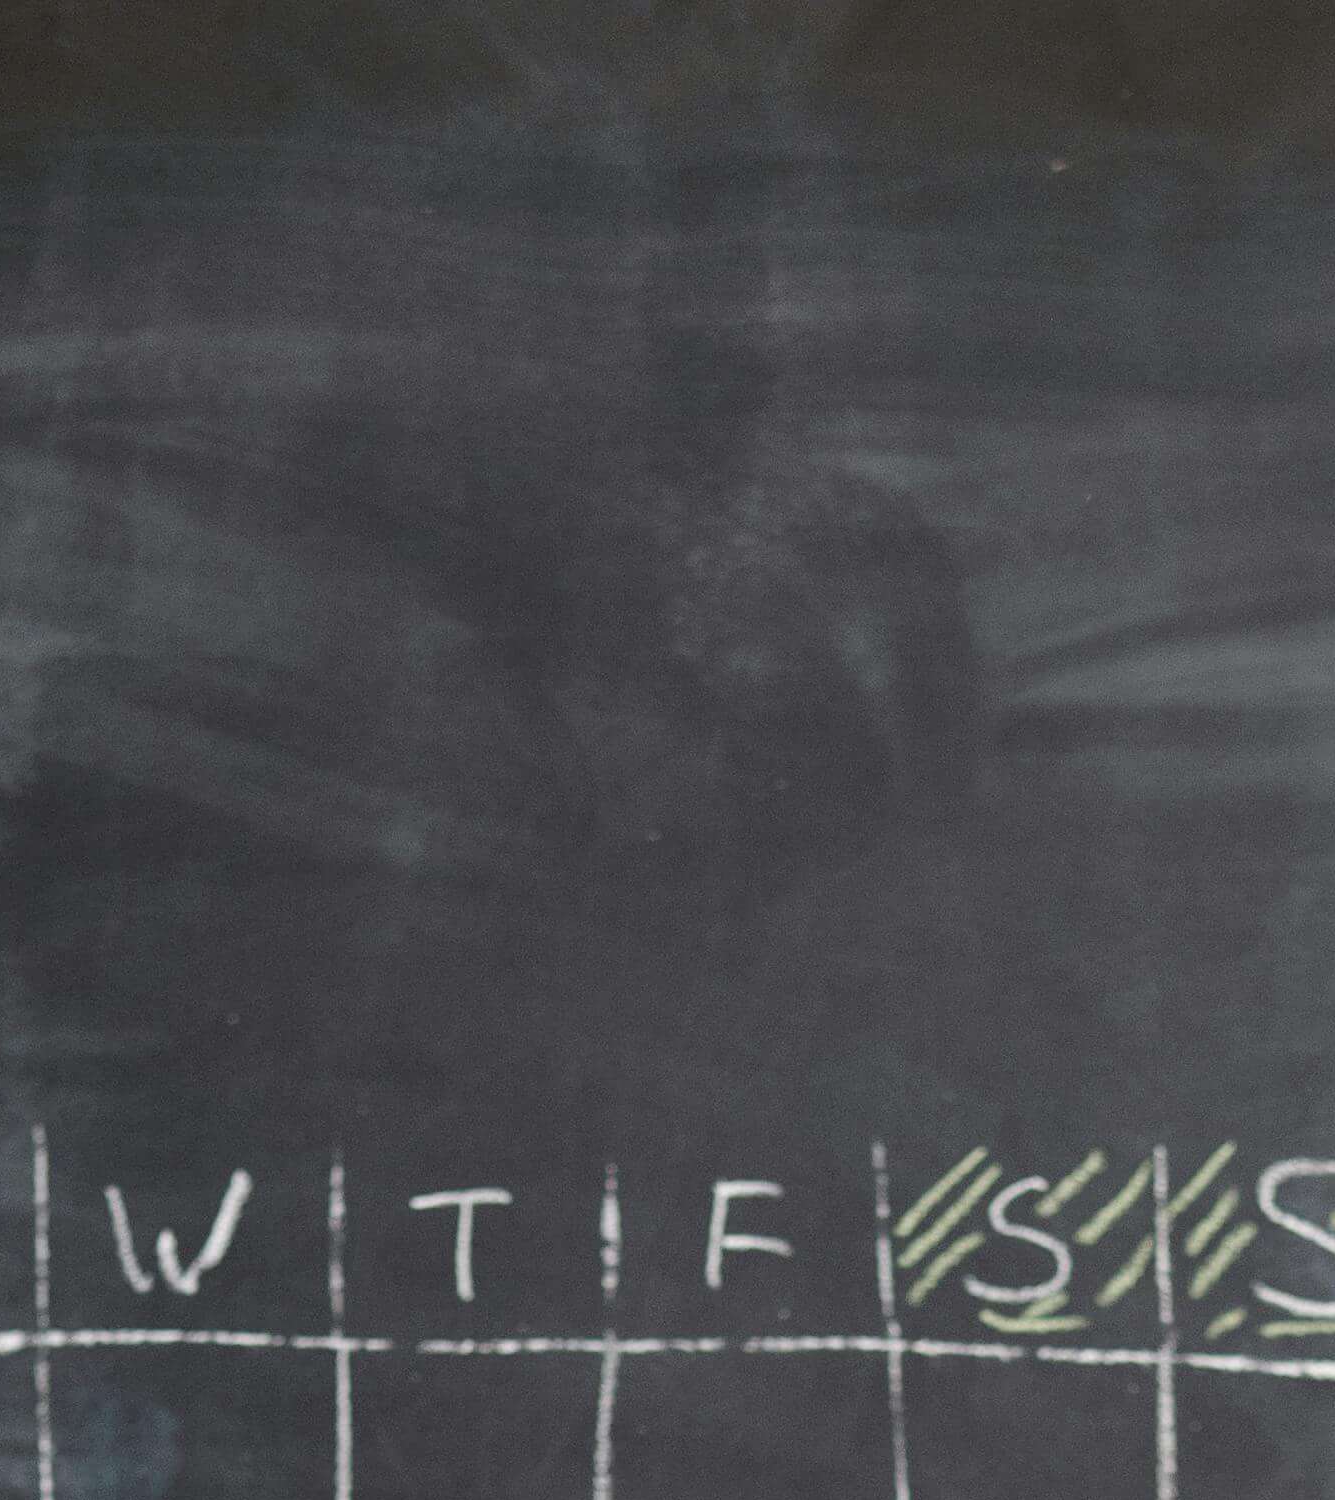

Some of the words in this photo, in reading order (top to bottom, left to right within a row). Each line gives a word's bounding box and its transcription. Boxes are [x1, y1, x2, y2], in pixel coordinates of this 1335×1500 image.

[105, 1169, 253, 1297] W
[409, 1187, 514, 1302] T
[704, 1179, 793, 1291] F
[963, 1174, 1074, 1304] S
